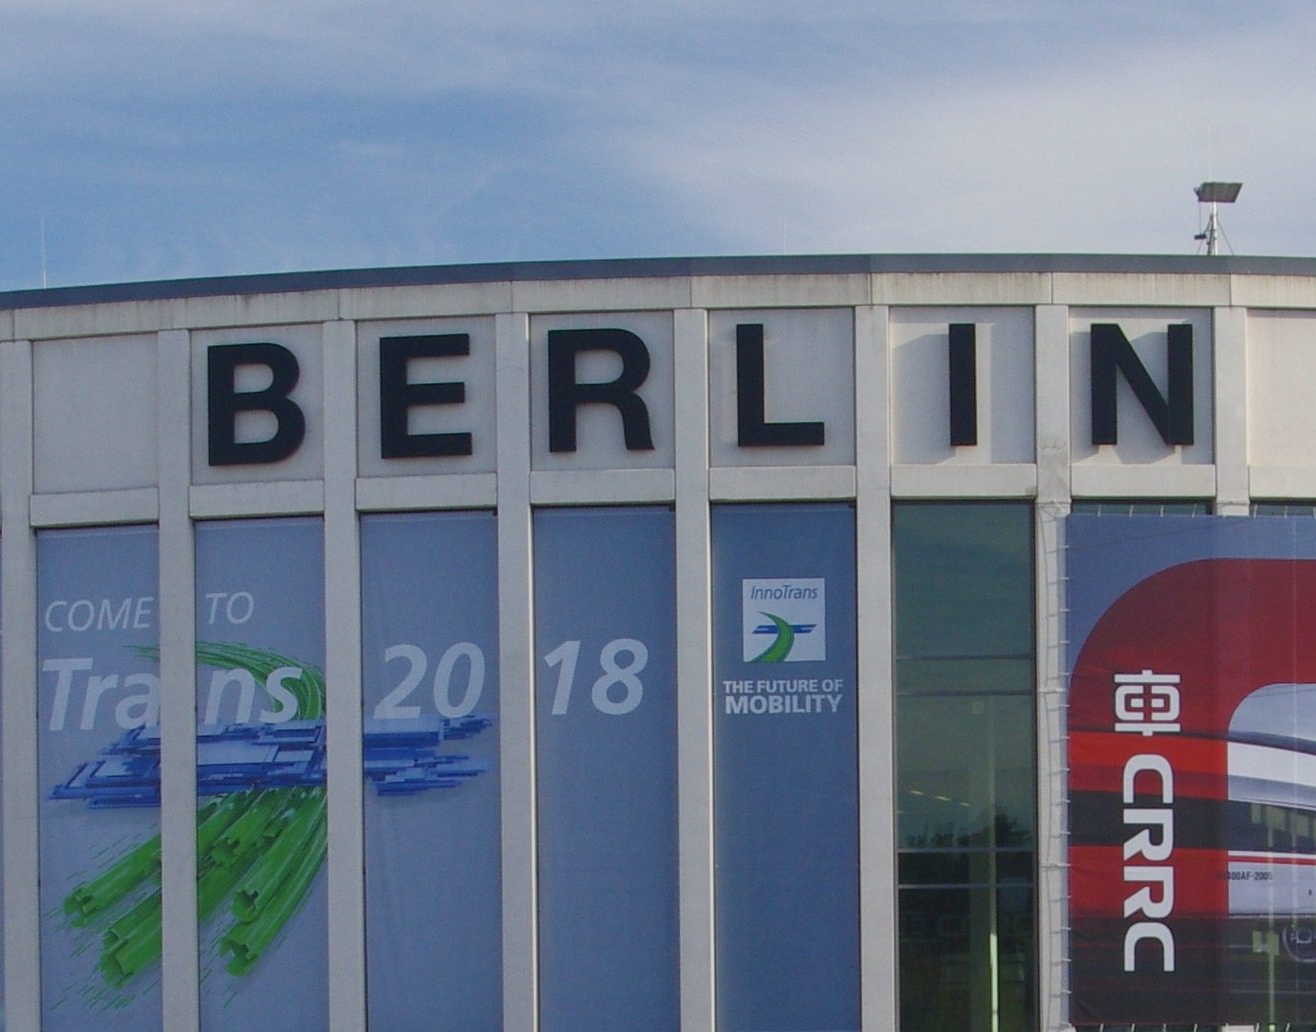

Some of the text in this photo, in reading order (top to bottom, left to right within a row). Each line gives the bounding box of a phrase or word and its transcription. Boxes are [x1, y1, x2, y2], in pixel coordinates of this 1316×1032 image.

[207, 323, 1195, 467] BERLIN
[750, 585, 818, 600] InnoTrans
[205, 592, 254, 625] TO
[723, 679, 843, 694] THE FUTURE OF
[725, 693, 843, 714] MOBILITY
[1122, 754, 1175, 972] CRRC
